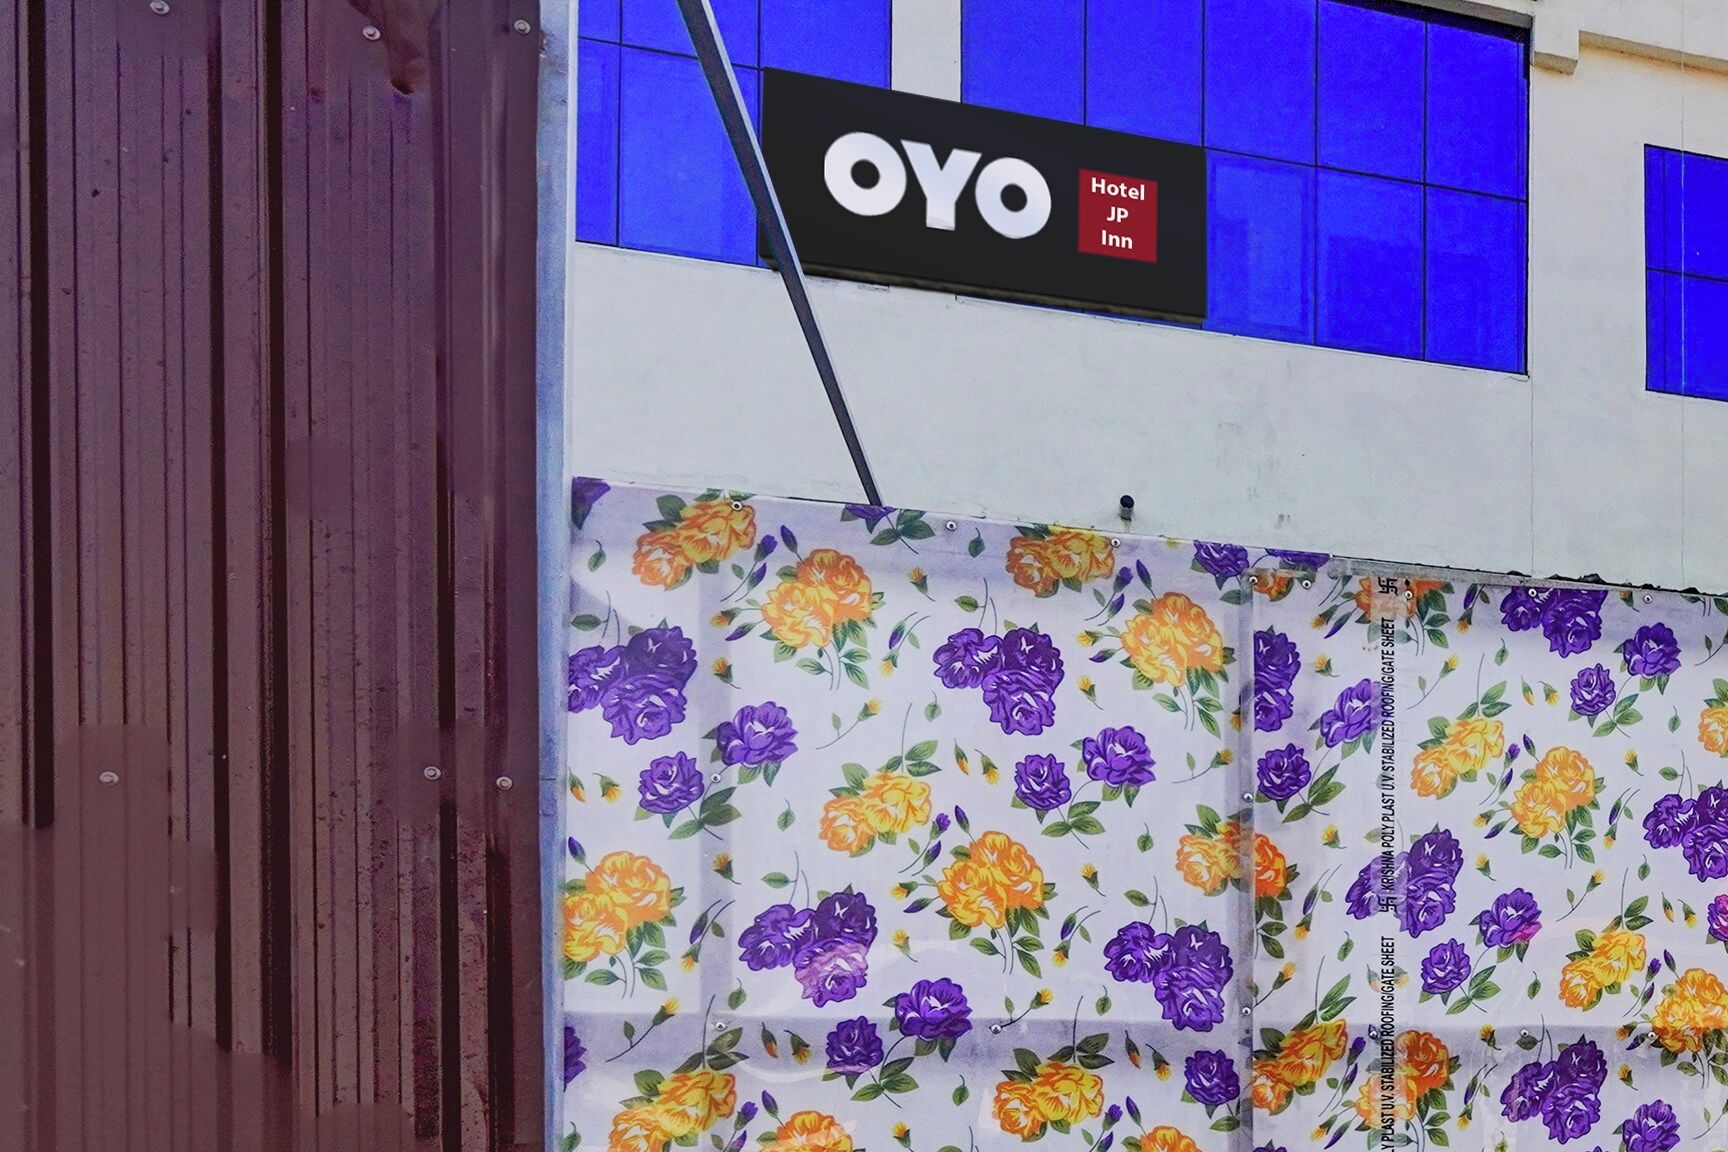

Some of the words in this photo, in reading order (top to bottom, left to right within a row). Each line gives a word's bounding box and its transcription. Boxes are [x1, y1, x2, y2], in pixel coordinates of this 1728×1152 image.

[824, 131, 1052, 239] OYO
[1091, 177, 1145, 201] Hotel
[1106, 205, 1129, 223] JP
[1100, 229, 1133, 250] Inn
[1381, 616, 1395, 648] SHEET
[1381, 650, 1395, 718] ROOFING/GATE
[1381, 719, 1395, 773] STABILIZED
[1381, 773, 1395, 791] U.V.
[1381, 792, 1395, 822] PLAST
[1381, 824, 1395, 848] POLY
[1381, 850, 1395, 891] KRISHNA
[1381, 936, 1395, 966] SHEET
[1381, 968, 1395, 1037] ROOFING/GATE
[1381, 1039, 1395, 1091] STABILIZED
[1381, 1092, 1395, 1110] U.V.
[1381, 1112, 1395, 1142] PLAST
